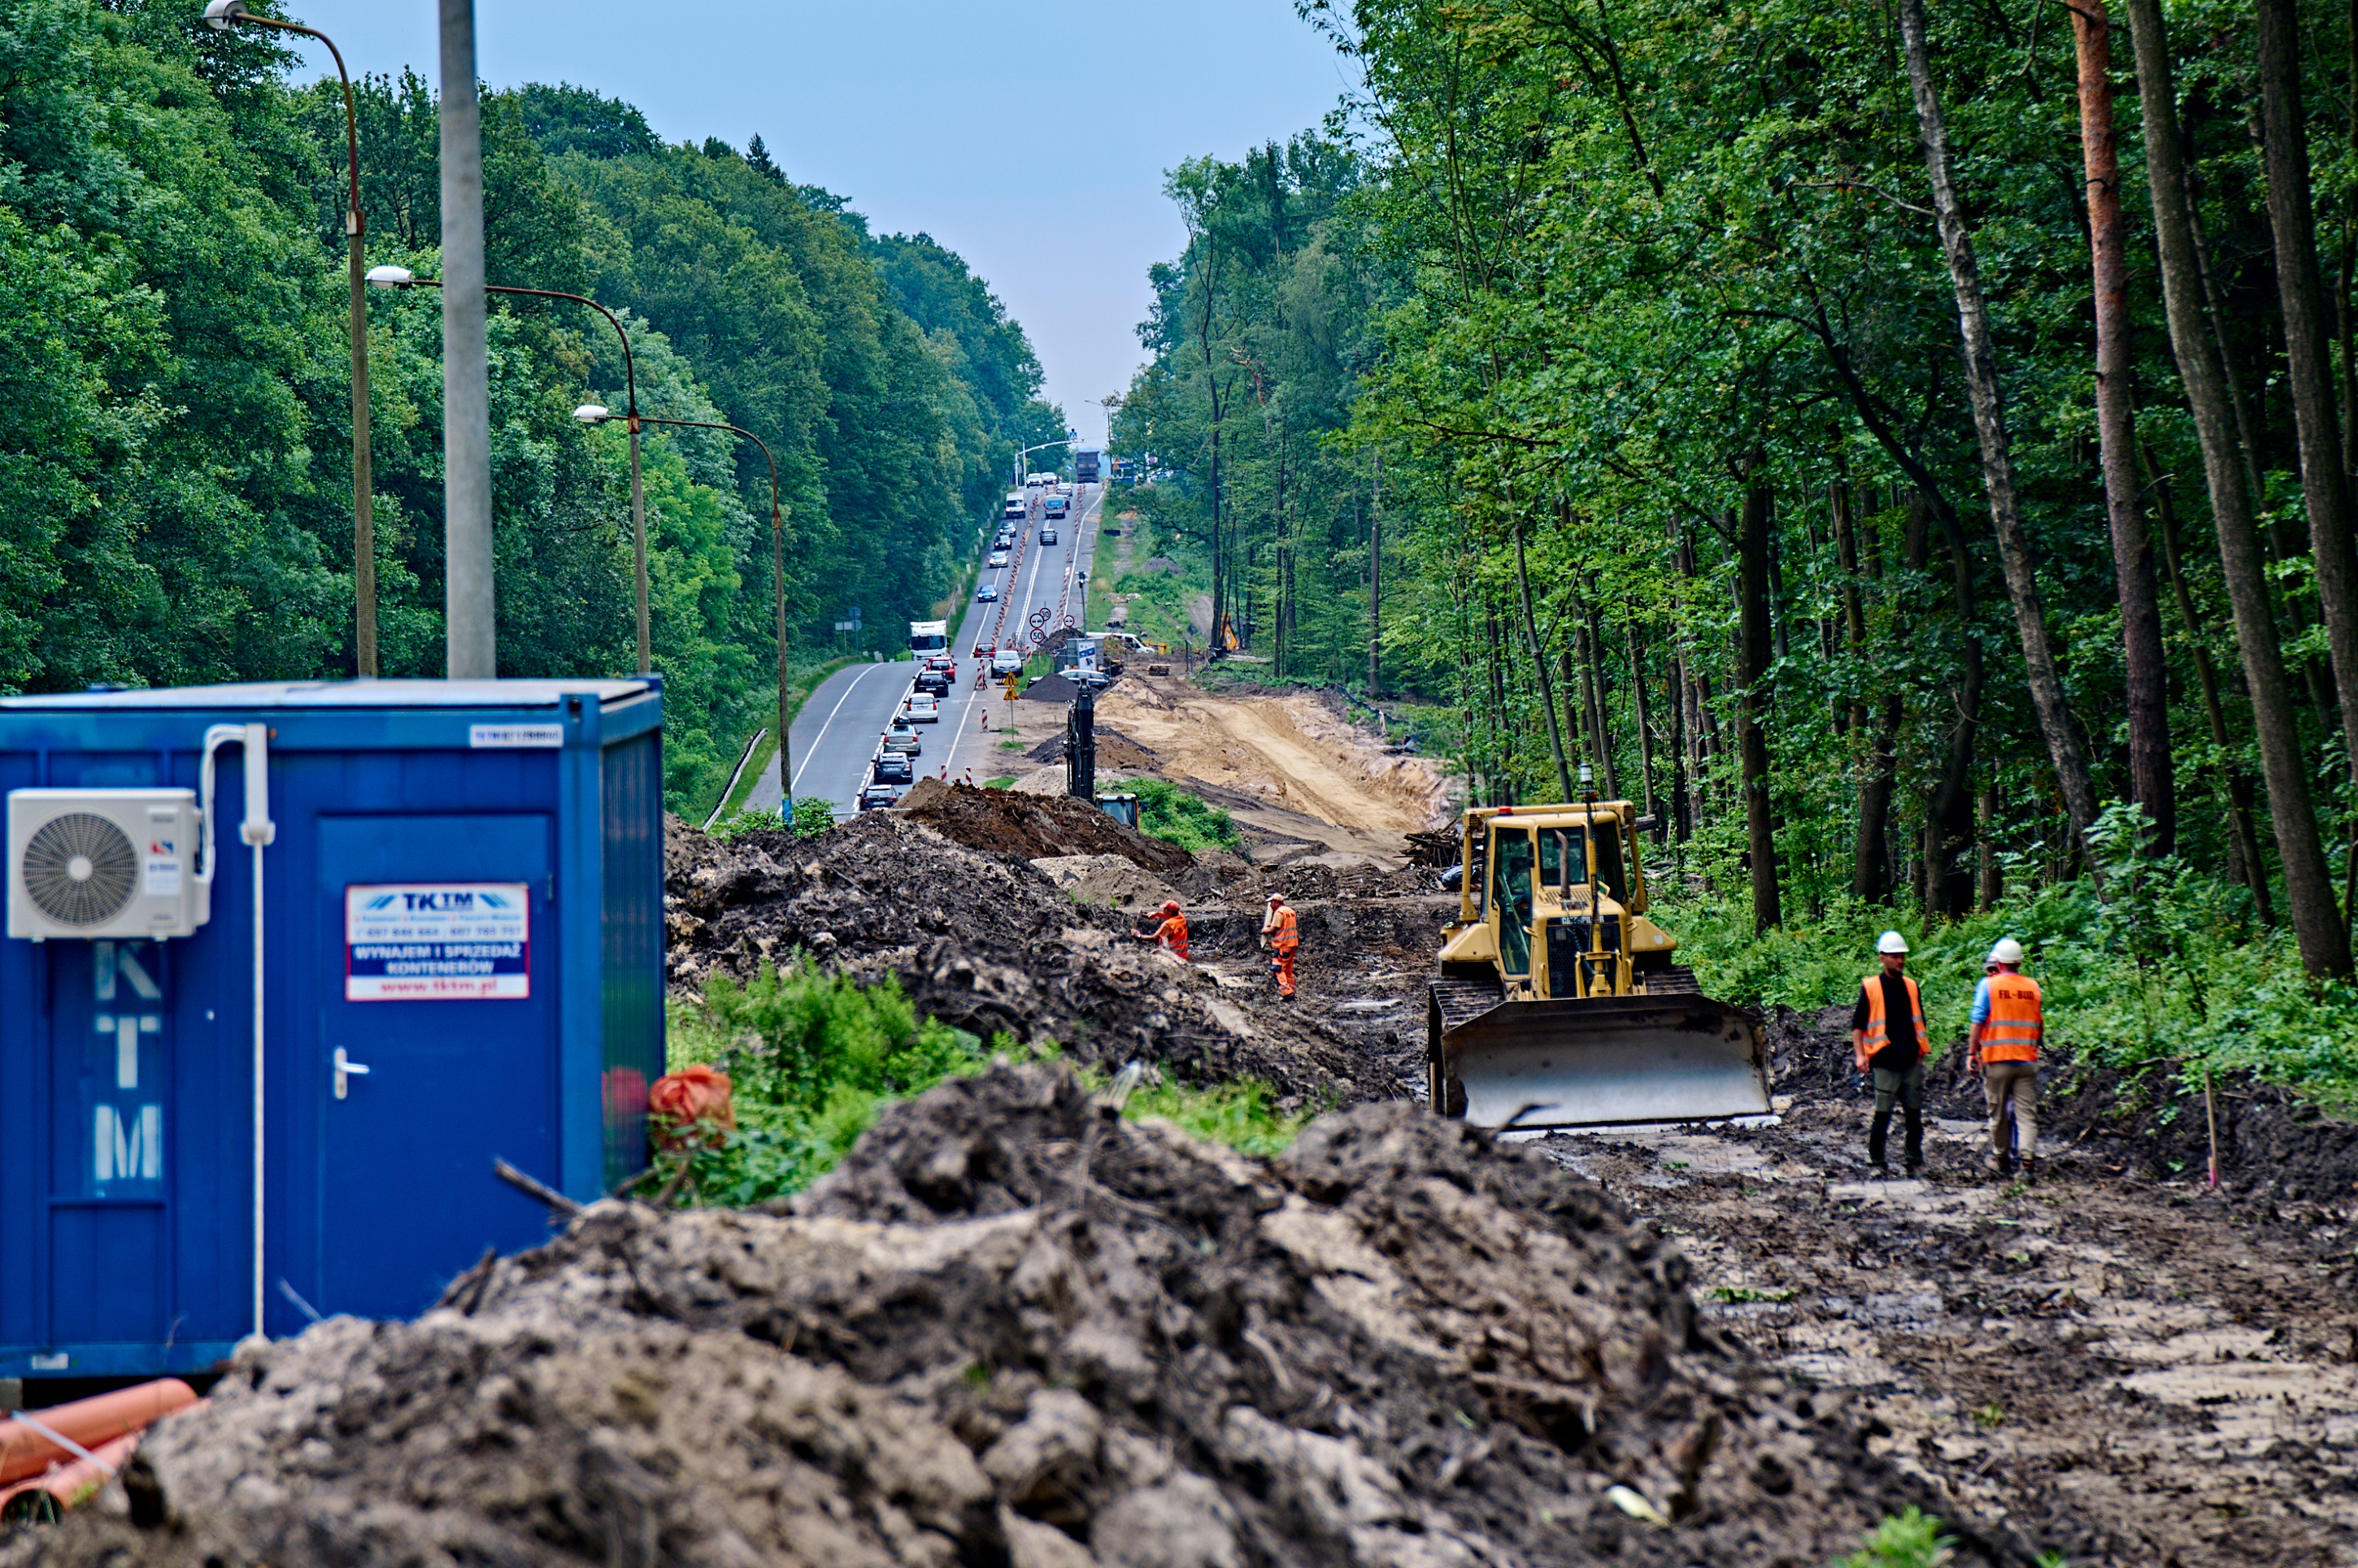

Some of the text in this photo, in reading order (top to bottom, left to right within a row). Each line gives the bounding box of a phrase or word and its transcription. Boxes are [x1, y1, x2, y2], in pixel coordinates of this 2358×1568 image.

[1033, 632, 1043, 640] 50
[403, 893, 473, 911] TKTM
[355, 942, 521, 959] WYNAJEM I SPRZEDAŻ
[386, 959, 494, 975] KONTENERÓW
[381, 978, 497, 995] www.tktm.pl
